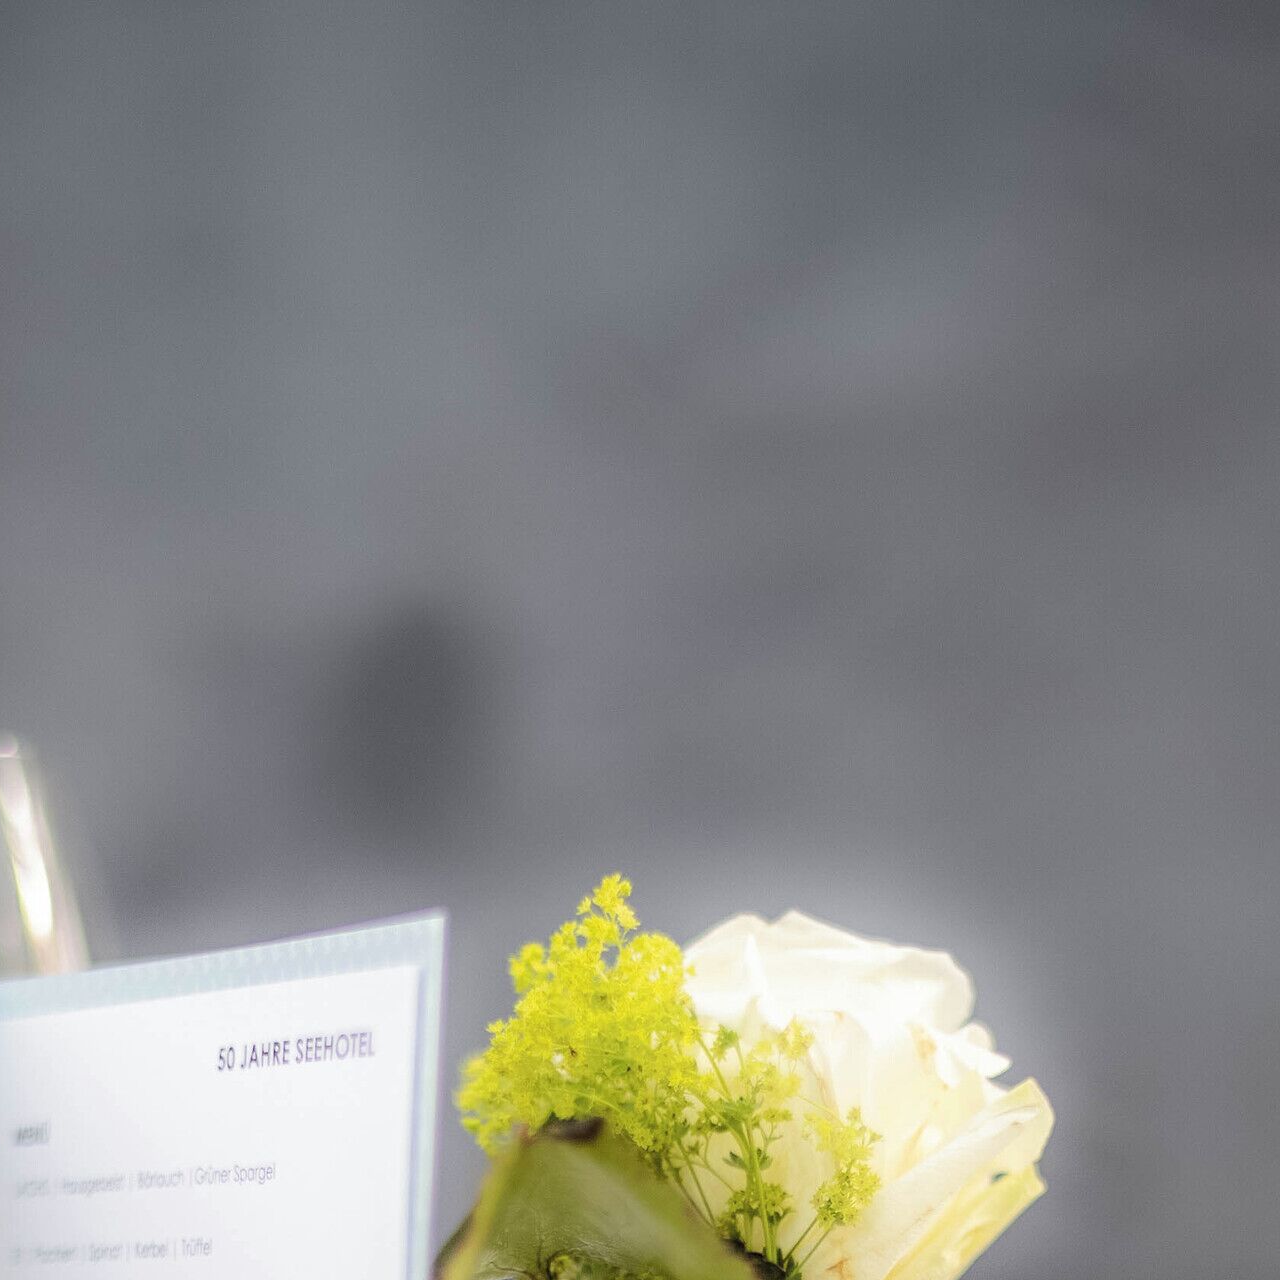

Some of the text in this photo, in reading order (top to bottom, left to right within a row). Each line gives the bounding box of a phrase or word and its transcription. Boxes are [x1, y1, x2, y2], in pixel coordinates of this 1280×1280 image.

[217, 1032, 375, 1071] 50 JAHRE SEEHOTEL
[233, 1162, 276, 1186] Spargel
